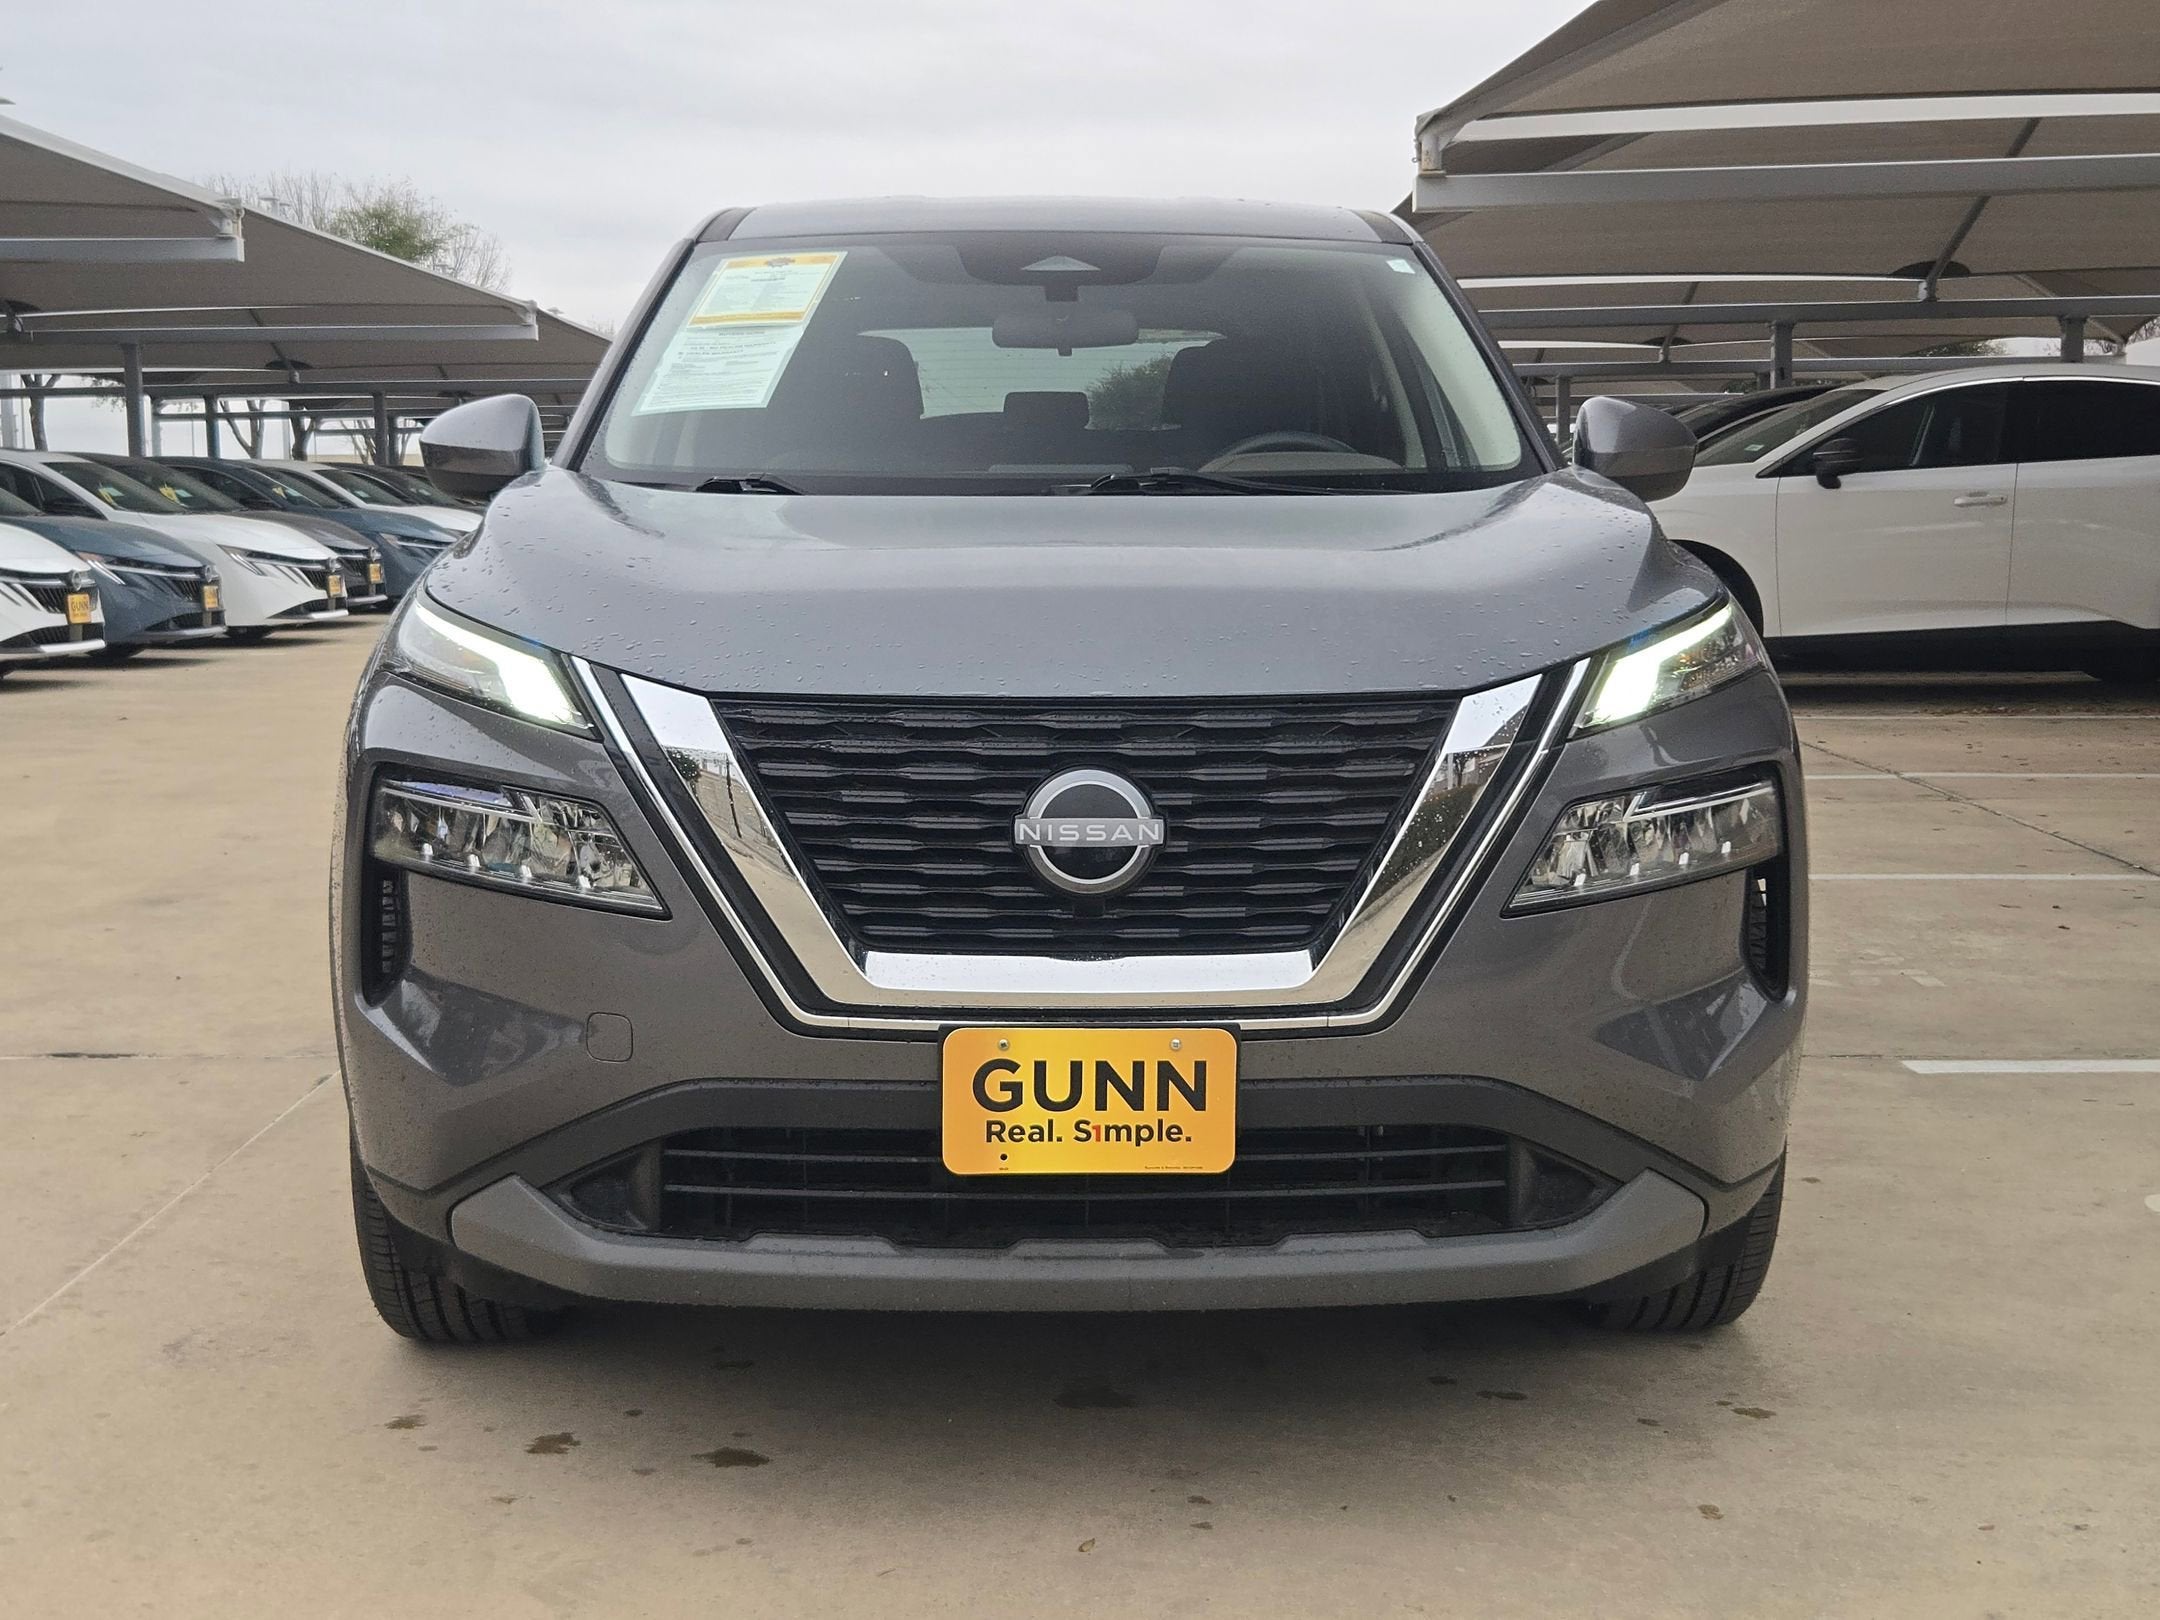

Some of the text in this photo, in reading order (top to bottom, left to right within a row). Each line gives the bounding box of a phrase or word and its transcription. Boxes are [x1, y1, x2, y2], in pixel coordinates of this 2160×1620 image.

[1019, 823, 1159, 841] NISSAN
[972, 1058, 1208, 1112] GUNN
[985, 1118, 1063, 1143] Real.
